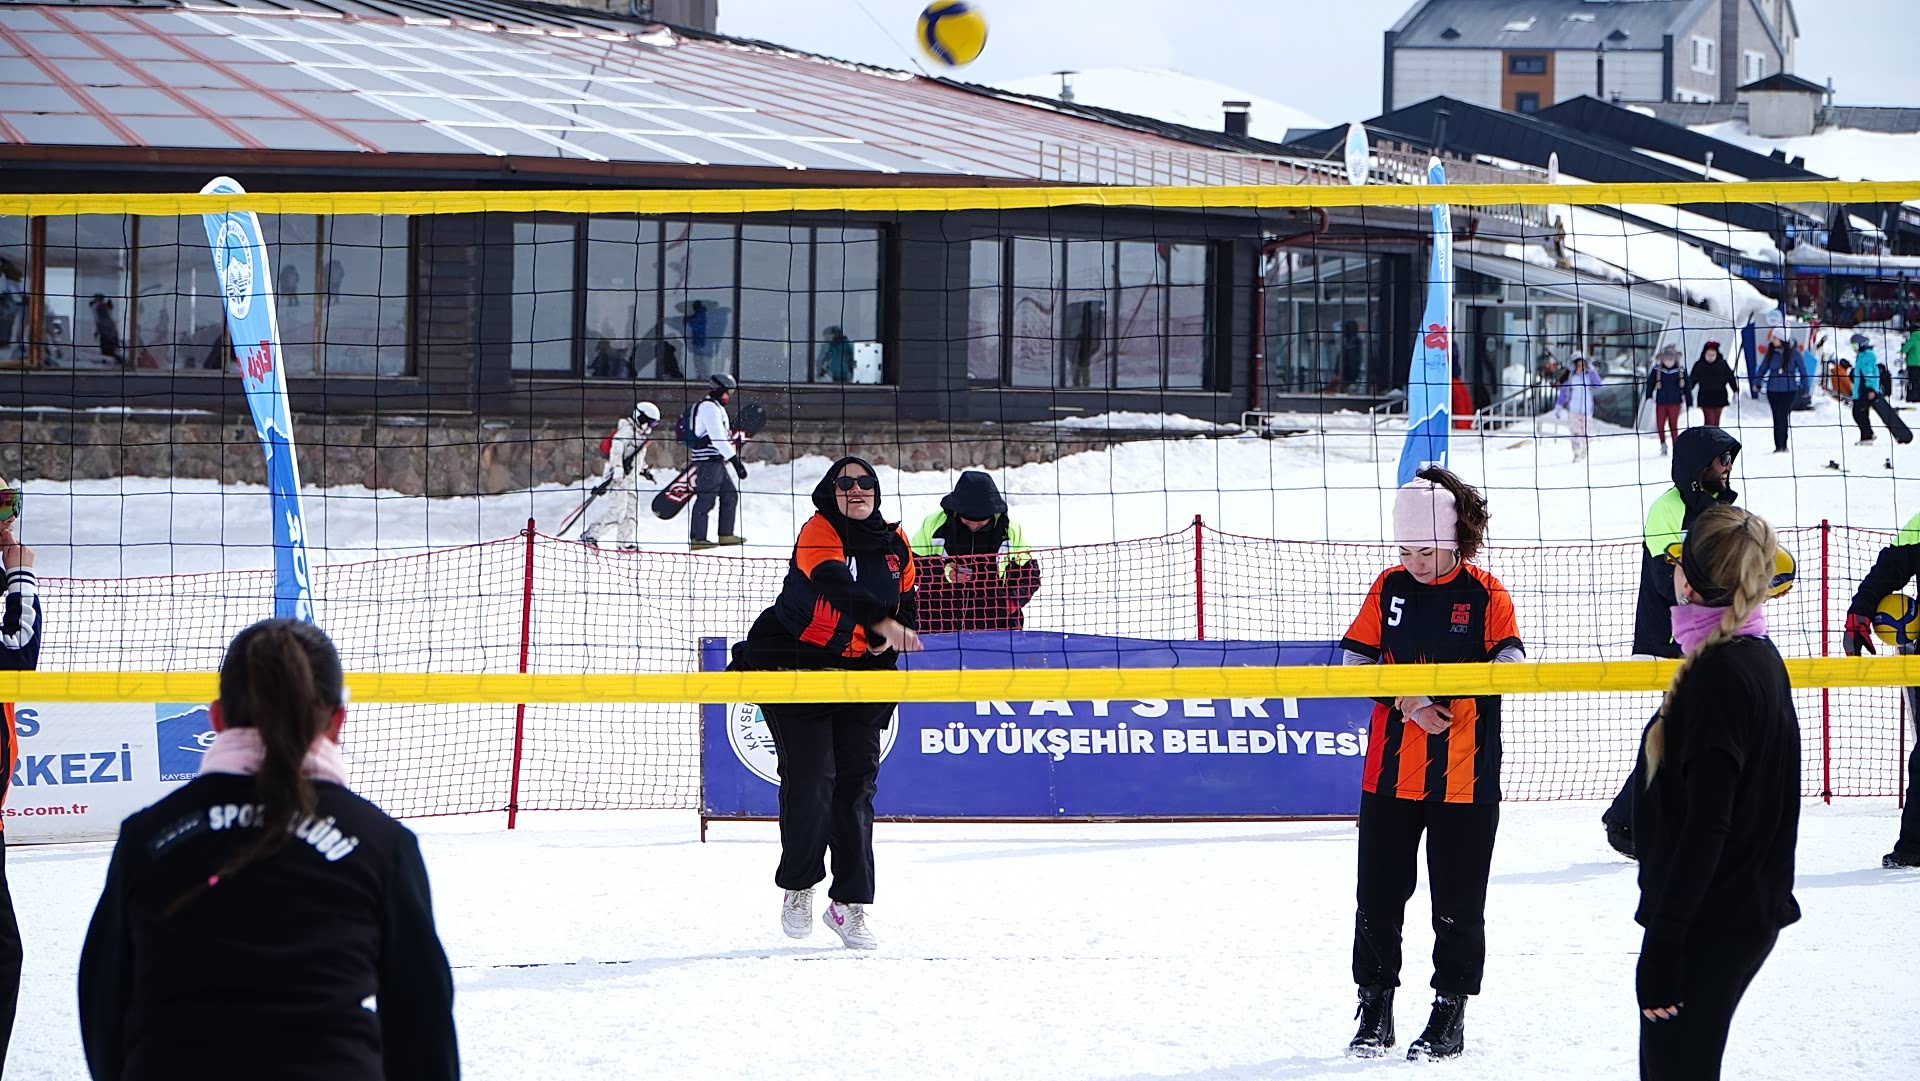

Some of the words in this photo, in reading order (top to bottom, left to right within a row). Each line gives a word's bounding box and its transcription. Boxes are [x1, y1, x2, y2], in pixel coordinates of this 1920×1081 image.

[1387, 596, 1406, 627] 5
[920, 722, 1156, 762] BÜYÜKŞEHİR
[1162, 723, 1369, 757] BELEDİYESİ
